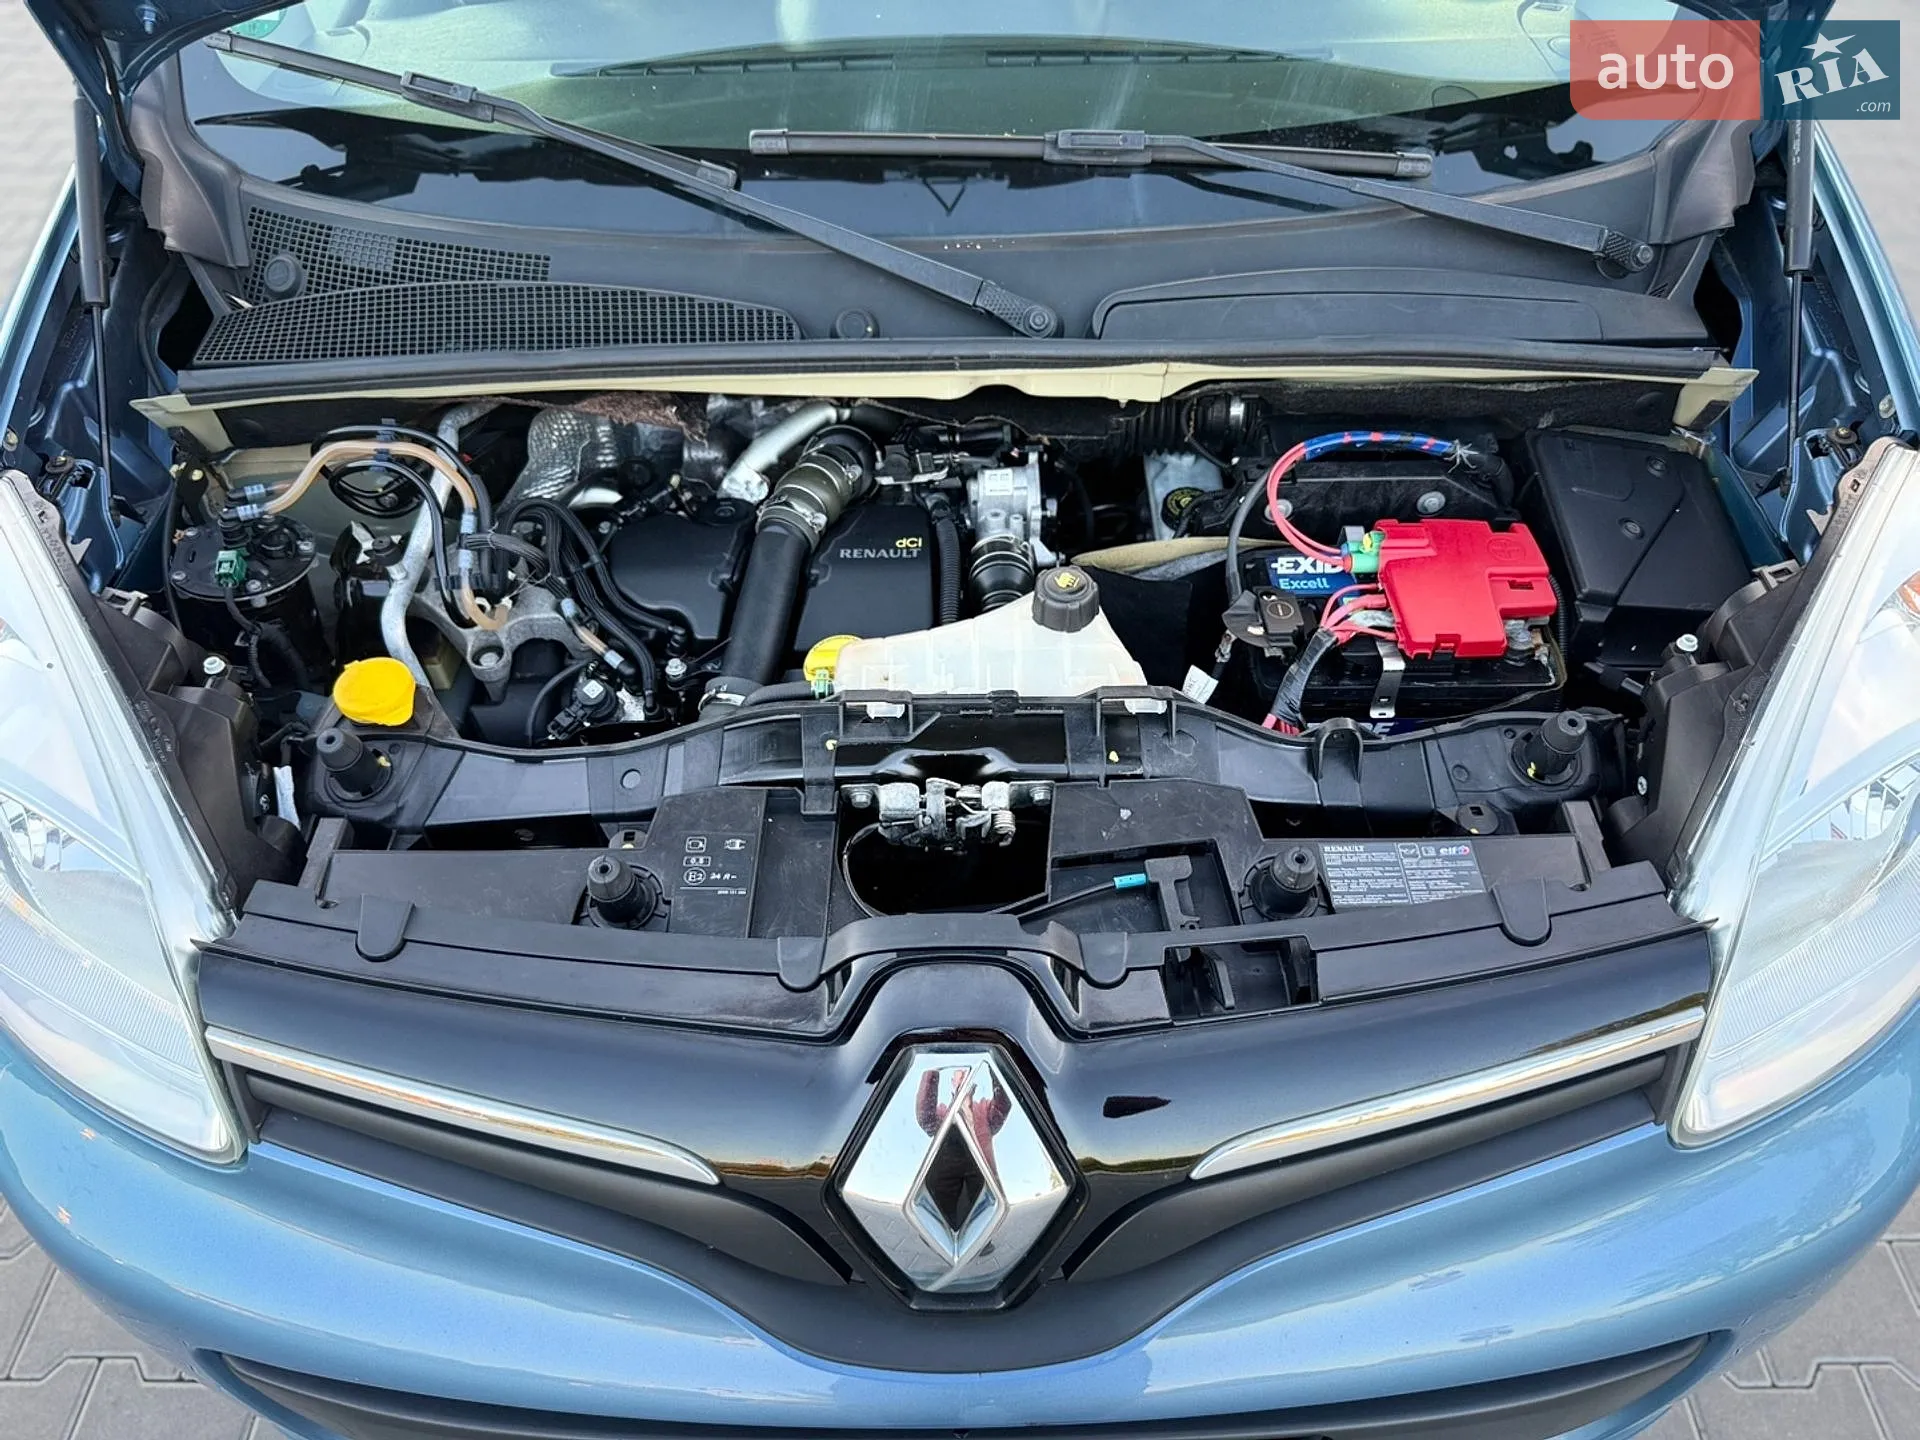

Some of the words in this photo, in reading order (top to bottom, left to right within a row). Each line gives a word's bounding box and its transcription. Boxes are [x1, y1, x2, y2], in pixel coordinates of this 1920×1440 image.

[839, 548, 921, 559] RENAULT
[1271, 556, 1344, 574] EXID
[1278, 577, 1331, 590] Excell
